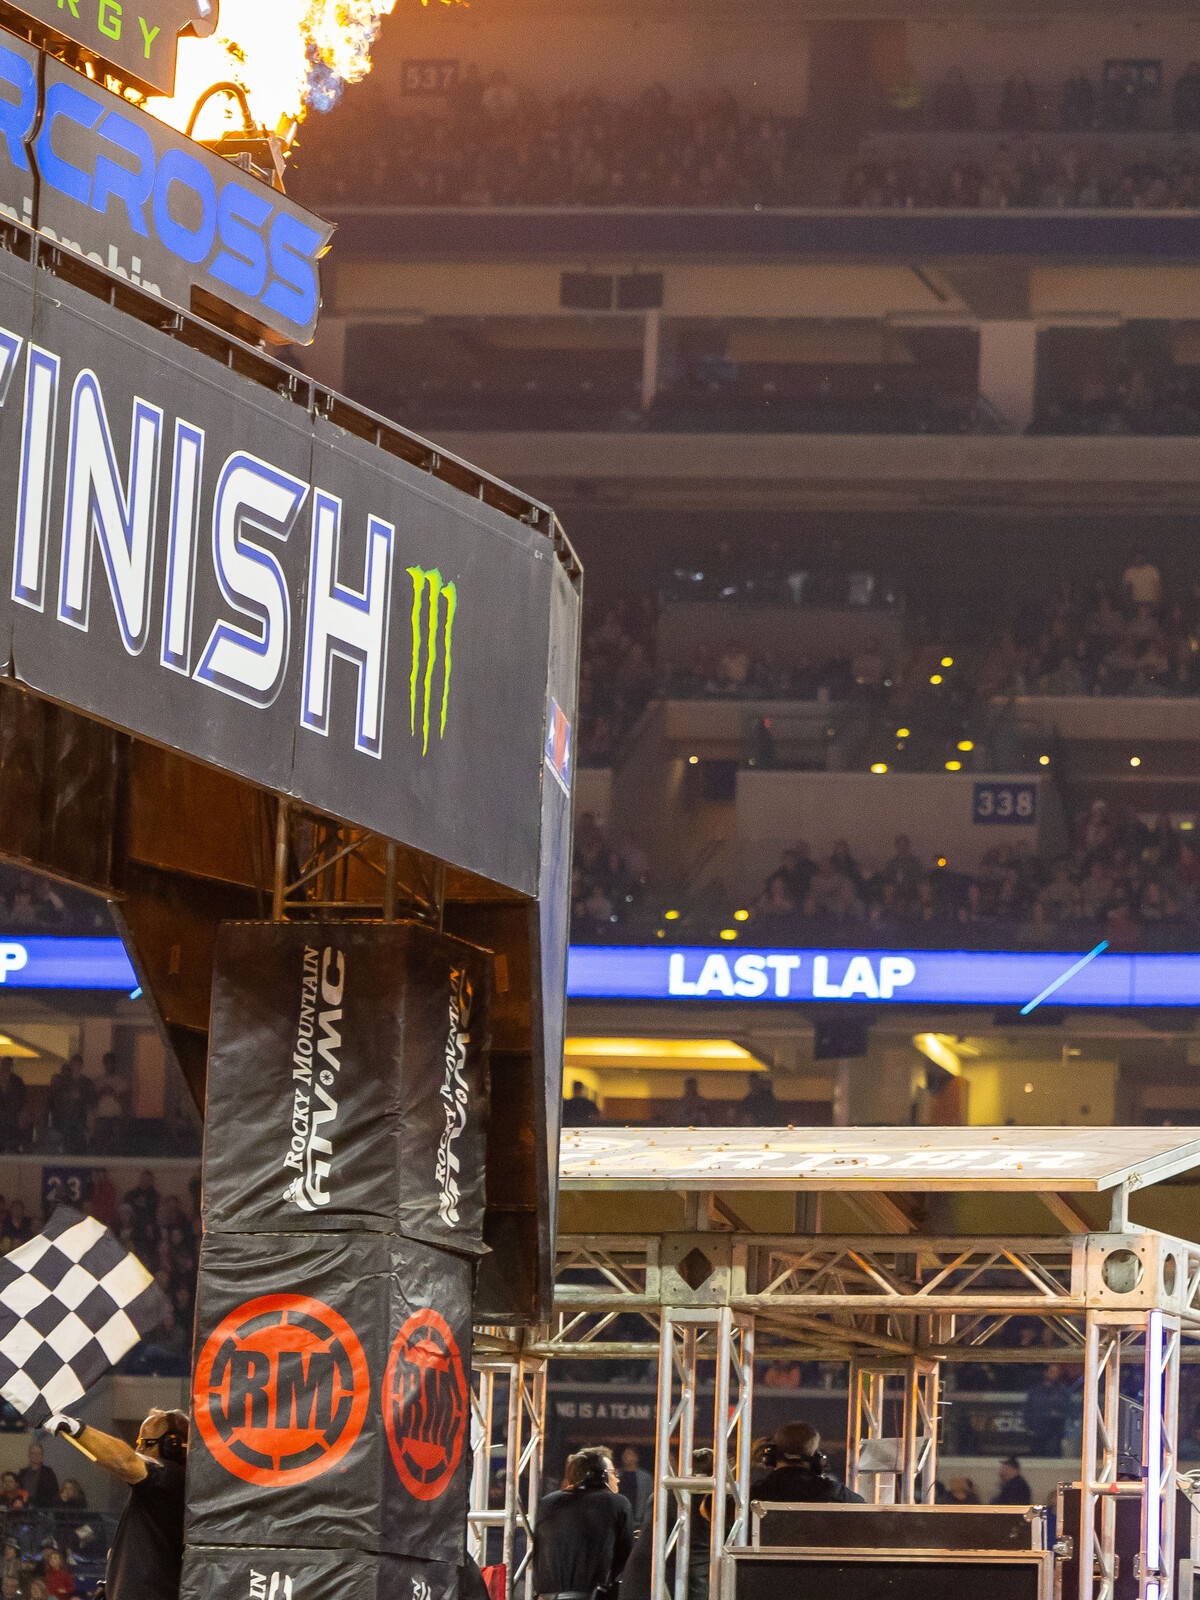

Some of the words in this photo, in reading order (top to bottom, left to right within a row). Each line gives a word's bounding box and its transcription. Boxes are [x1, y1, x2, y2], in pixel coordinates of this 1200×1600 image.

[406, 66, 454, 90] 537
[0, 327, 395, 760] INISH
[978, 790, 1033, 817] 338
[668, 953, 801, 998] LAST
[812, 955, 916, 999] LAP
[293, 945, 320, 1086] MOUNTAIN
[284, 1088, 310, 1172] ROCKY
[435, 1102, 457, 1187] ROCKY
[46, 1175, 84, 1202] 23
[225, 1350, 337, 1430] RM
[610, 1403, 650, 1419] TEAM
